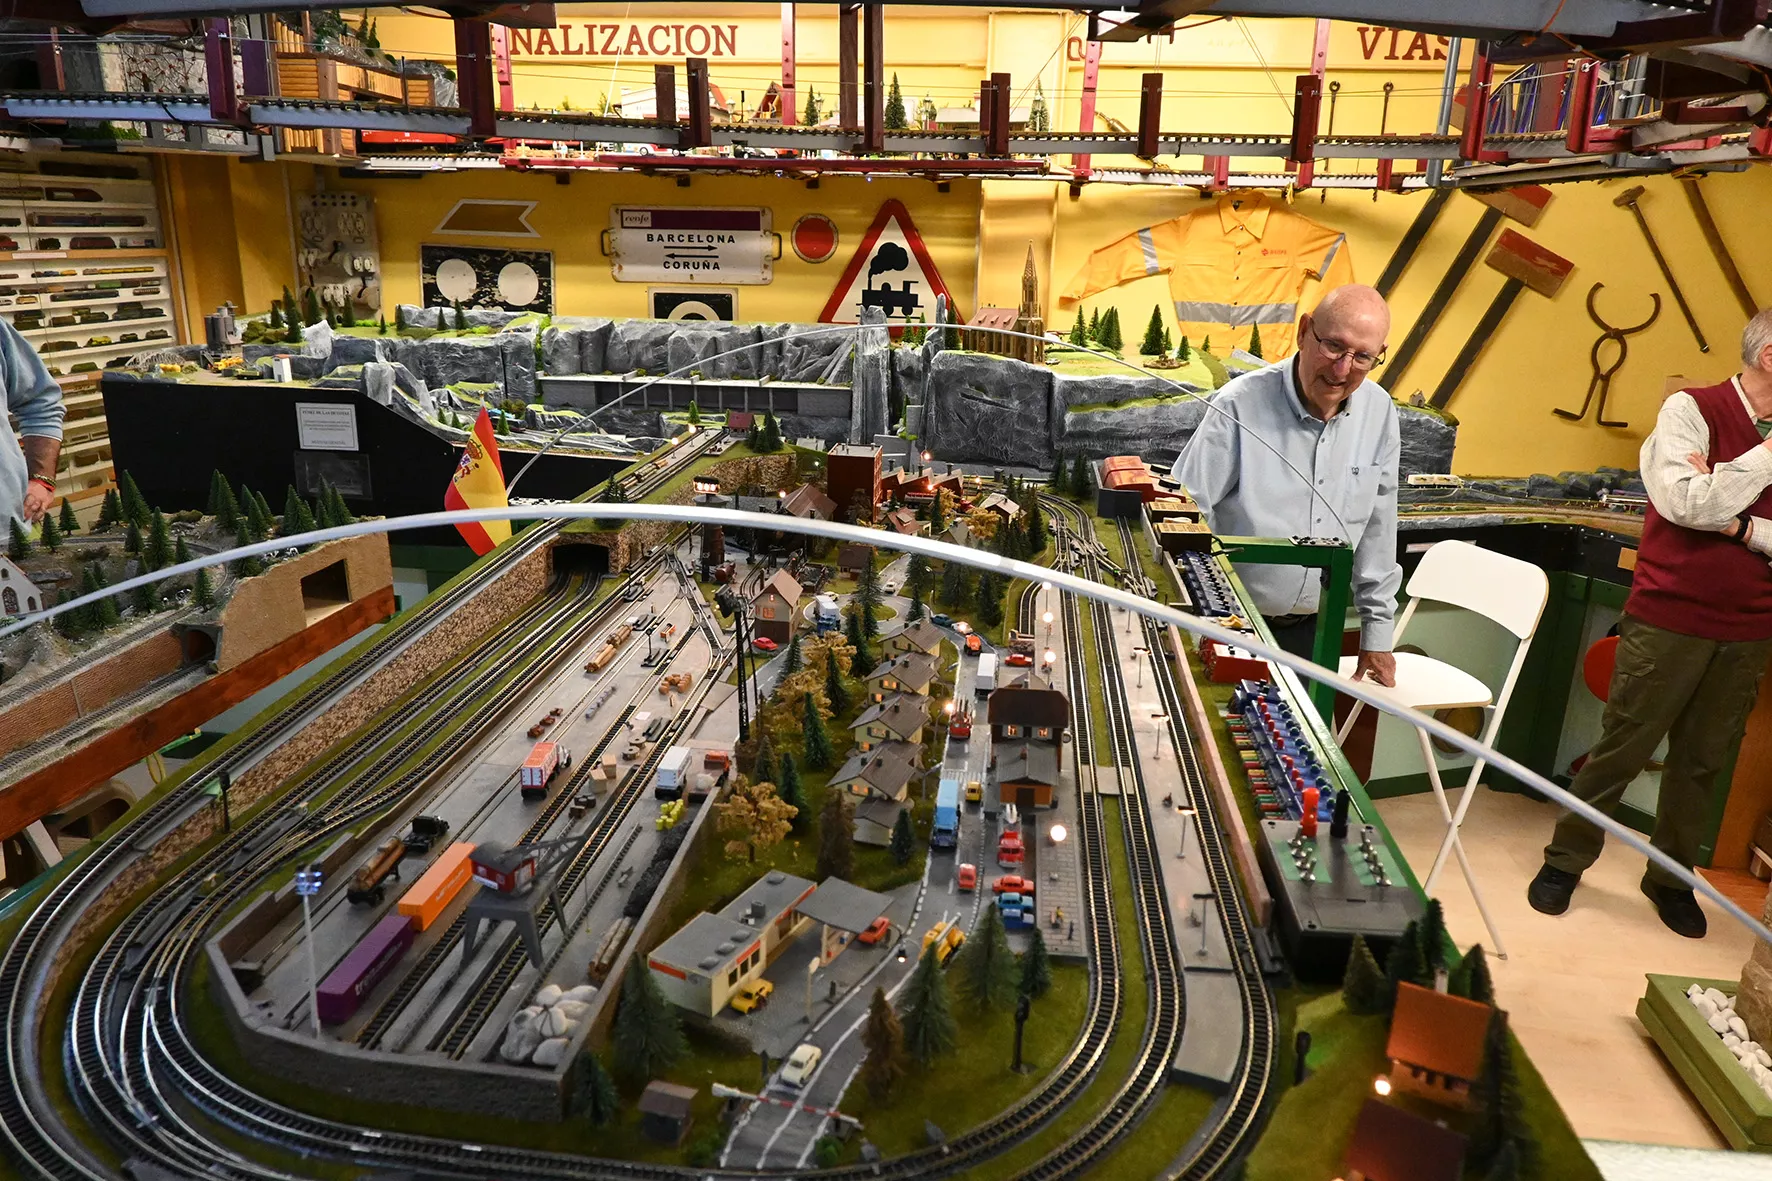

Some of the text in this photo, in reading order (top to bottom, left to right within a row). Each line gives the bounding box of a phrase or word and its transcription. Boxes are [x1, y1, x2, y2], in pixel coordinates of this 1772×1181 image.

[490, 24, 739, 56] NALIZACION
[624, 213, 650, 225] renfe
[646, 233, 736, 244] BARCELONA
[663, 260, 720, 271] CORUÑA
